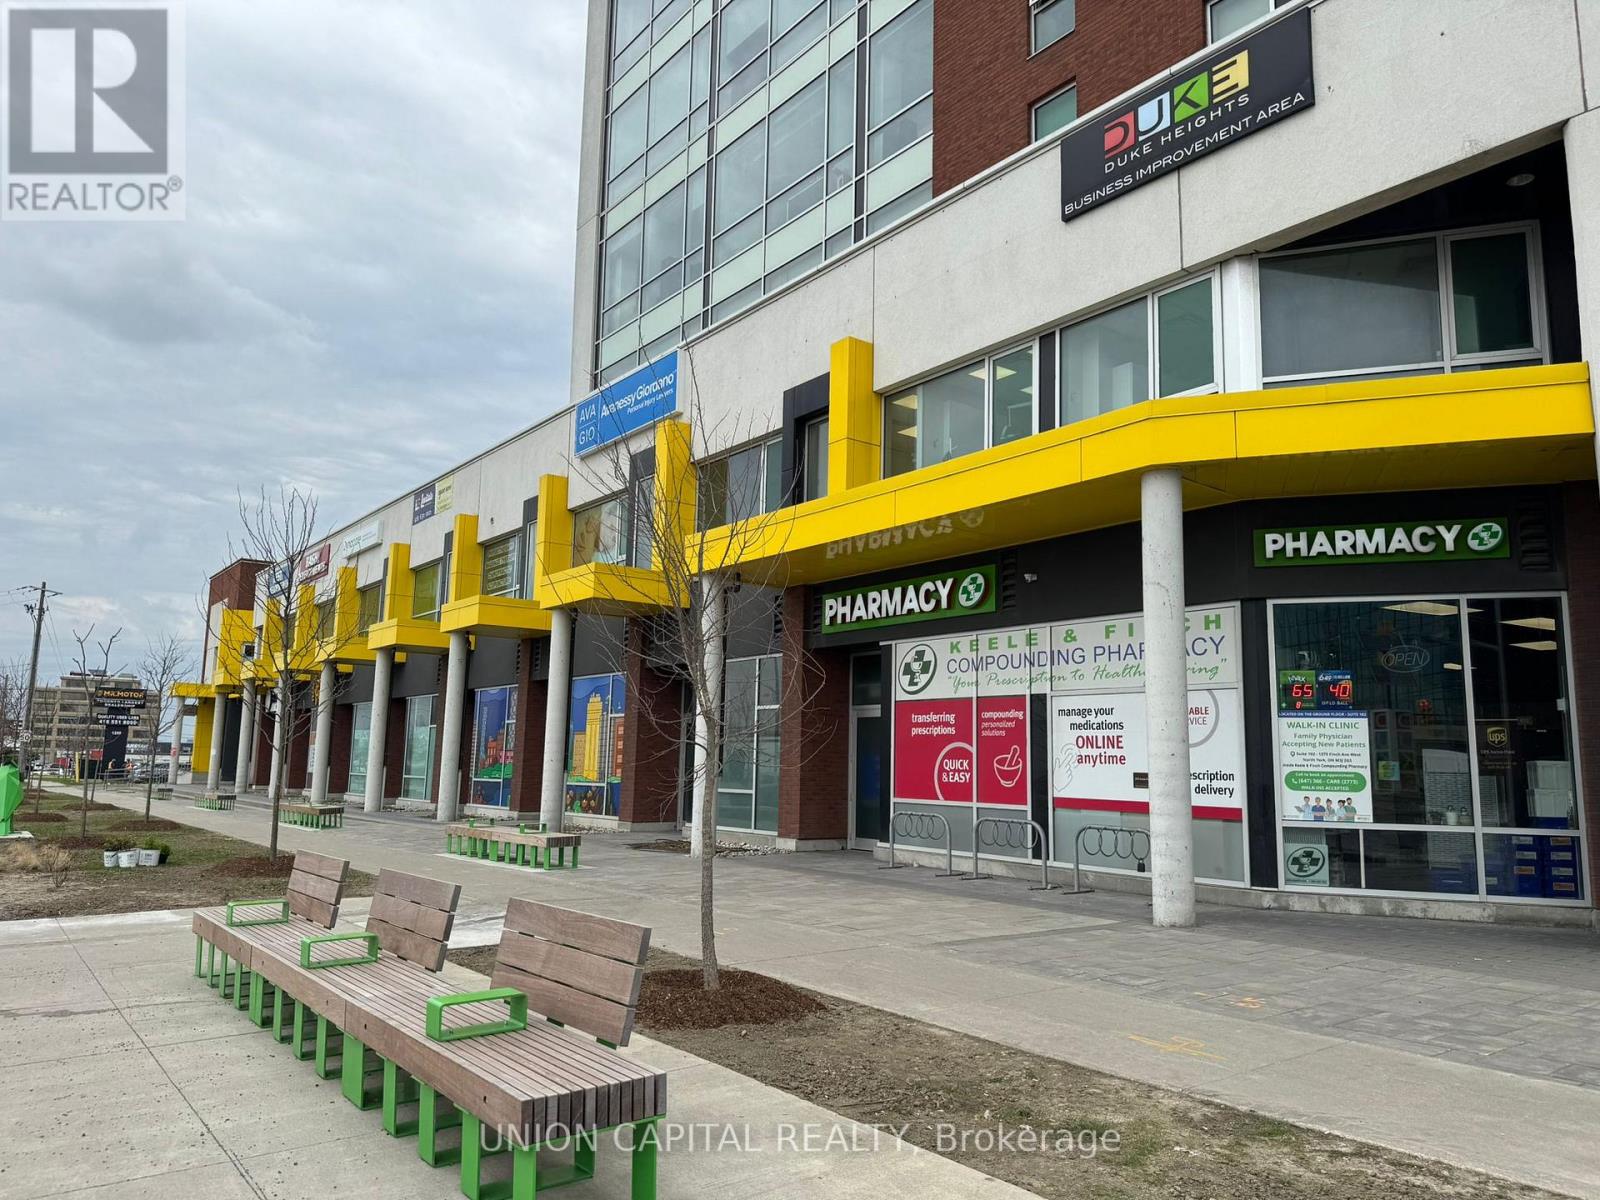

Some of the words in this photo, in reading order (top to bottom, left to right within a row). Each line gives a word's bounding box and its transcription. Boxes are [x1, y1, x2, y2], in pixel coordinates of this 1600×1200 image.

[1104, 50, 1249, 160] DUKE
[1104, 143, 1152, 174] DUKE
[1161, 93, 1250, 146] HEIGHTS
[1064, 174, 1132, 214] BUSINESS
[1136, 118, 1252, 181] IMPROVEMENT
[1256, 92, 1305, 124] AREA
[580, 404, 596, 423] AVA
[580, 426, 595, 444] GIO
[1265, 524, 1462, 559] PHARMACY
[825, 578, 954, 626] PHARMACY
[950, 632, 1038, 654] KEELE
[1064, 628, 1078, 644] &
[1104, 613, 1222, 640] FIH
[946, 648, 1086, 674] COMPOUNDING
[1094, 634, 1226, 662] PHACY
[1385, 652, 1424, 666] OPEN
[987, 672, 1068, 690] Prescription
[1070, 667, 1085, 681] to
[1292, 684, 1312, 697] 65
[1330, 684, 1350, 697] 40
[982, 709, 1024, 720] compounding
[1058, 708, 1092, 718] manage
[1094, 707, 1114, 718] your
[1188, 706, 1210, 715] ABLE
[912, 712, 956, 724] transferring
[981, 720, 1016, 728] personalized
[912, 725, 956, 737] prescriptions
[1070, 720, 1124, 731] medications
[1076, 735, 1124, 750] ONLINE
[1490, 733, 1505, 744] ups
[943, 759, 969, 771] QUICK
[1077, 751, 1126, 768] anytime
[1194, 784, 1234, 798] delivery
